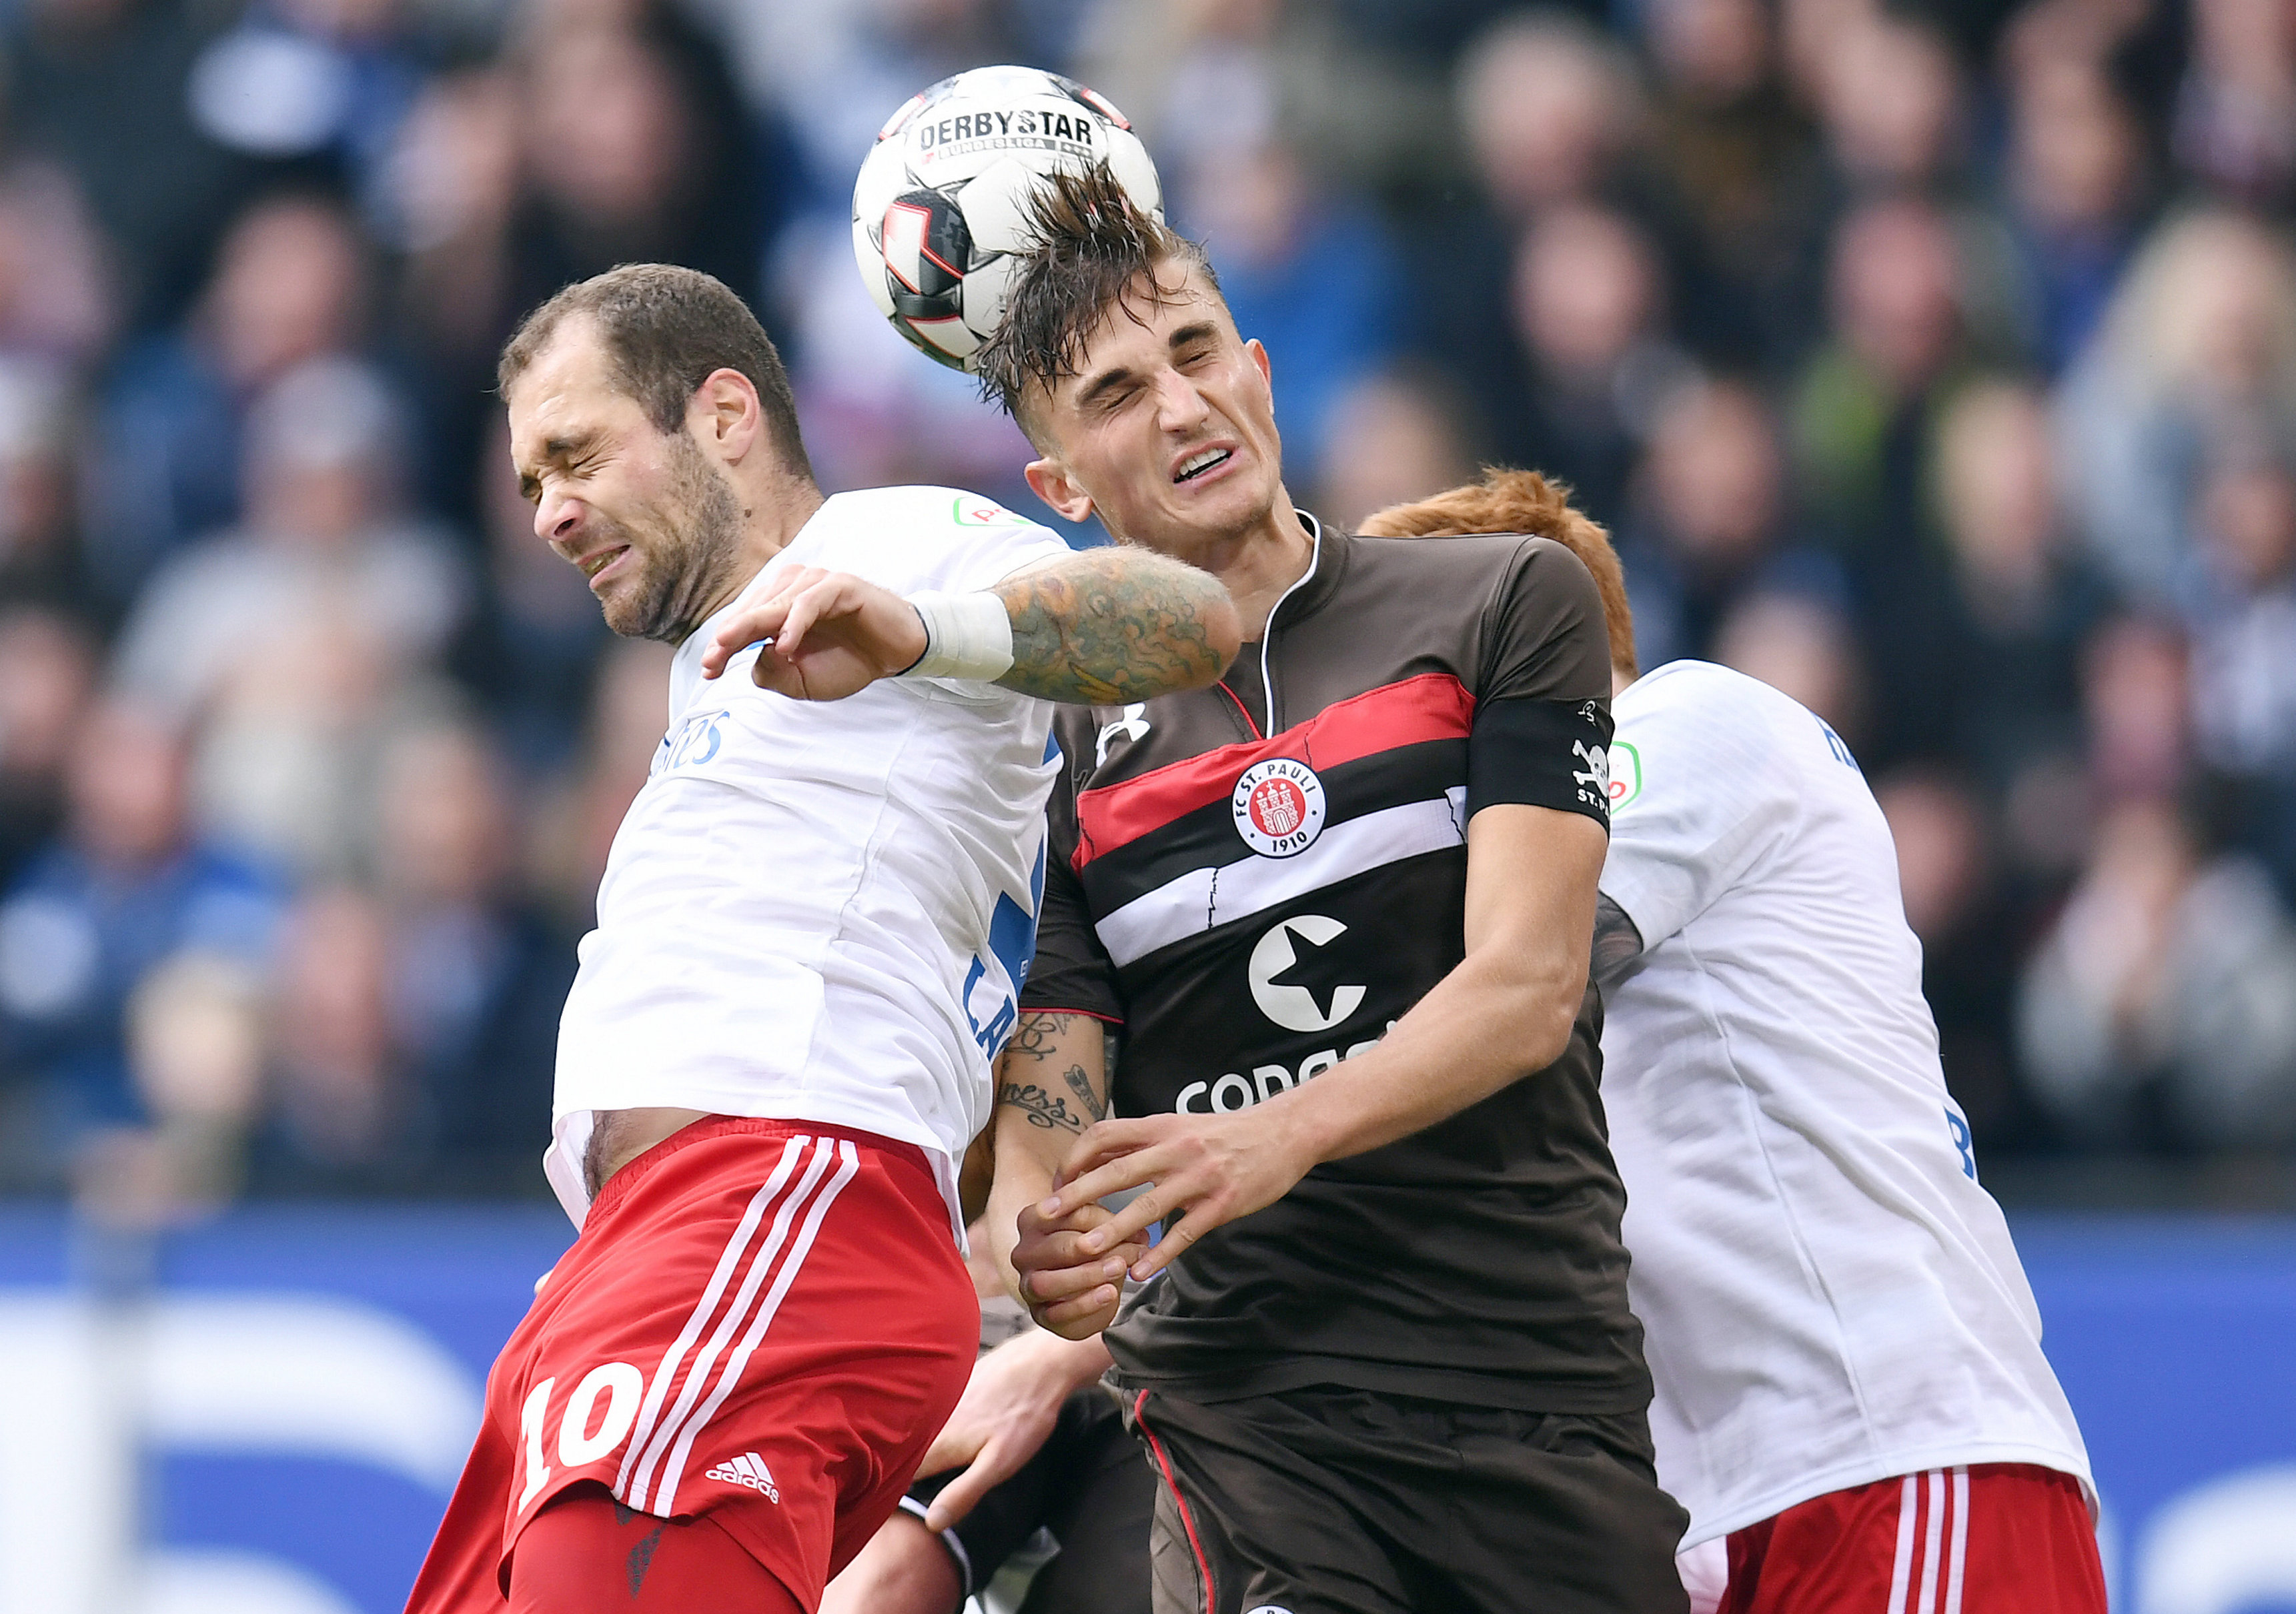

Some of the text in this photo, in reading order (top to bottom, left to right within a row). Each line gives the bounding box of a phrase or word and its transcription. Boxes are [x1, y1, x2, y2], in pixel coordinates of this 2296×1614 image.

[921, 109, 1092, 151] DERBYSTAR
[1235, 764, 1316, 817] FC ST. PAULI
[1272, 831, 1307, 852] 1910
[518, 1362, 643, 1517] 10
[704, 1469, 780, 1505] adidas
